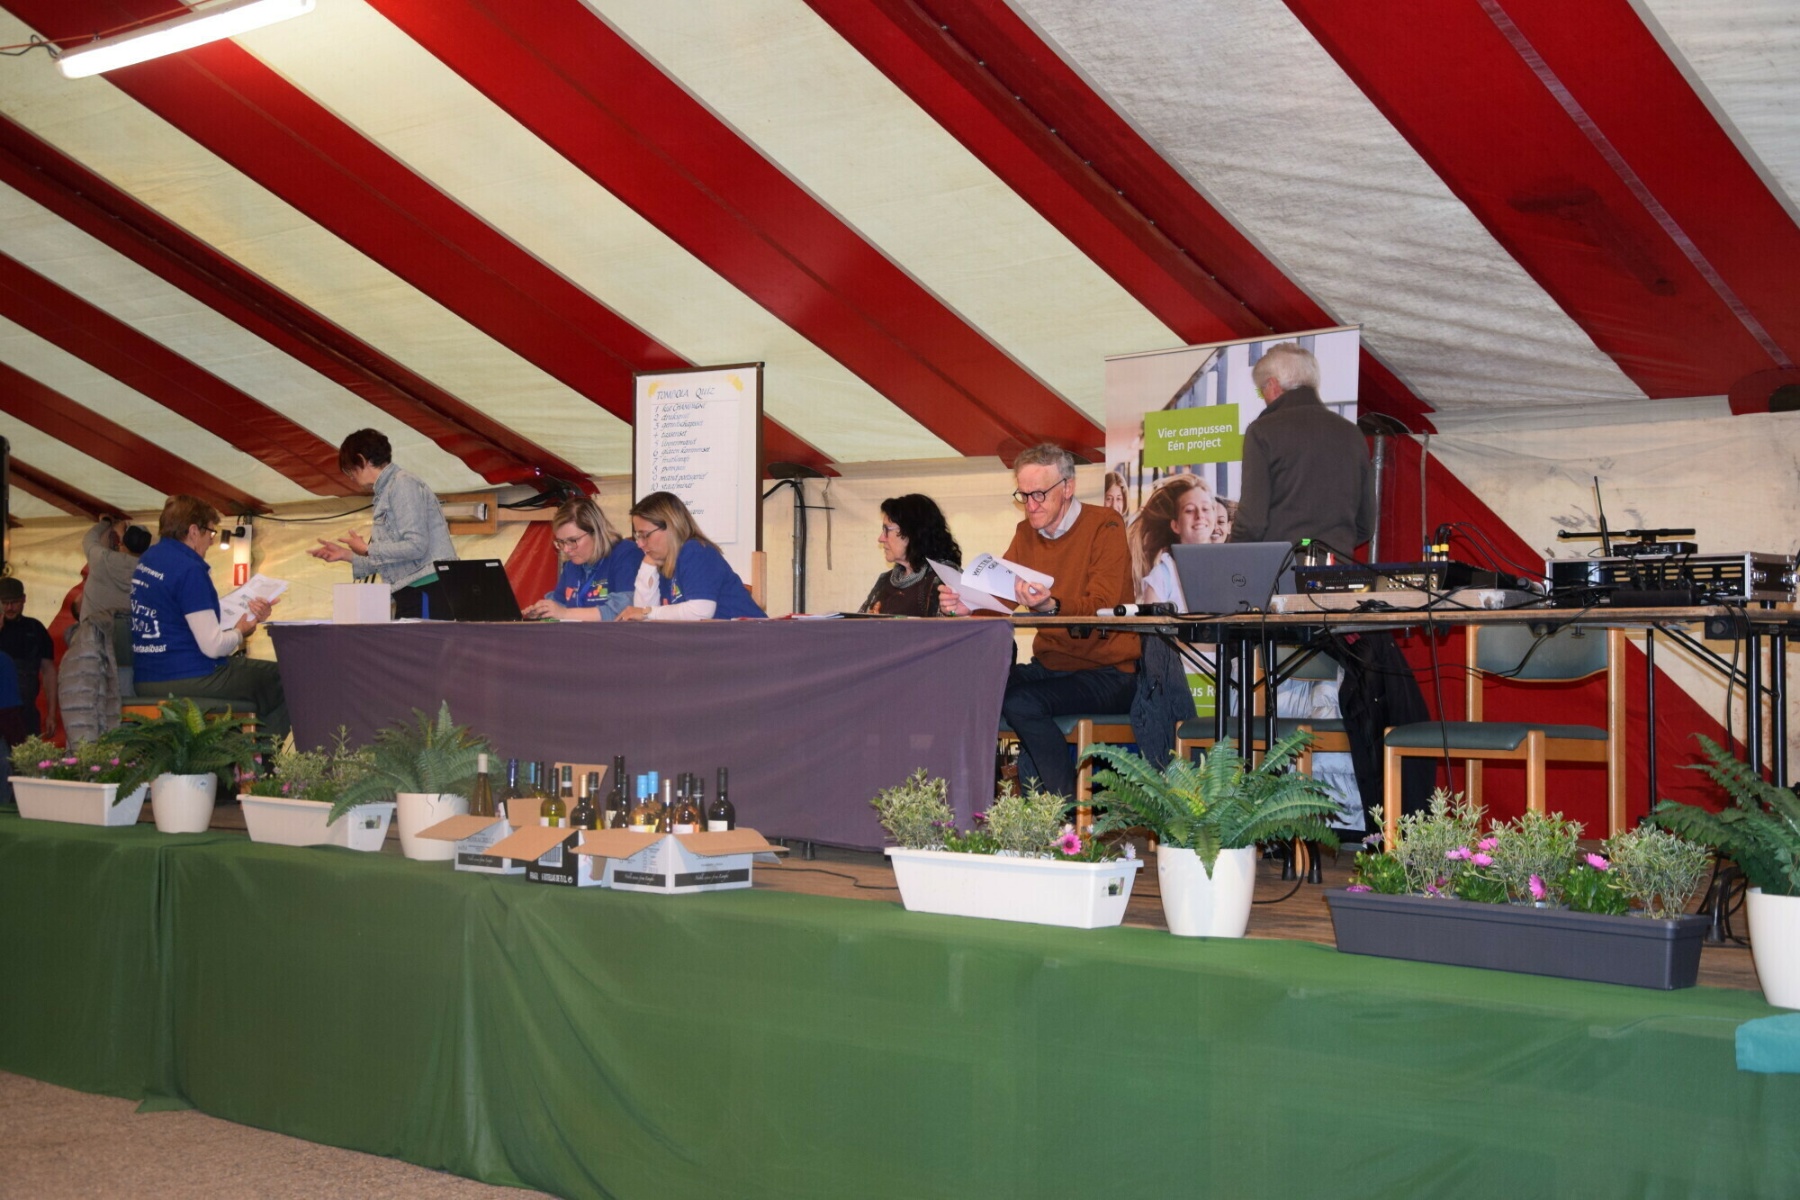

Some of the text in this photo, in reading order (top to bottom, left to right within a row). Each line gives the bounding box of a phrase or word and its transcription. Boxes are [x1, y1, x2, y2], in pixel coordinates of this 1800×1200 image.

[656, 387, 715, 400] TOMBOLA QUIZ
[1157, 423, 1233, 439] Vier campussen
[1167, 437, 1222, 452] Eén project
